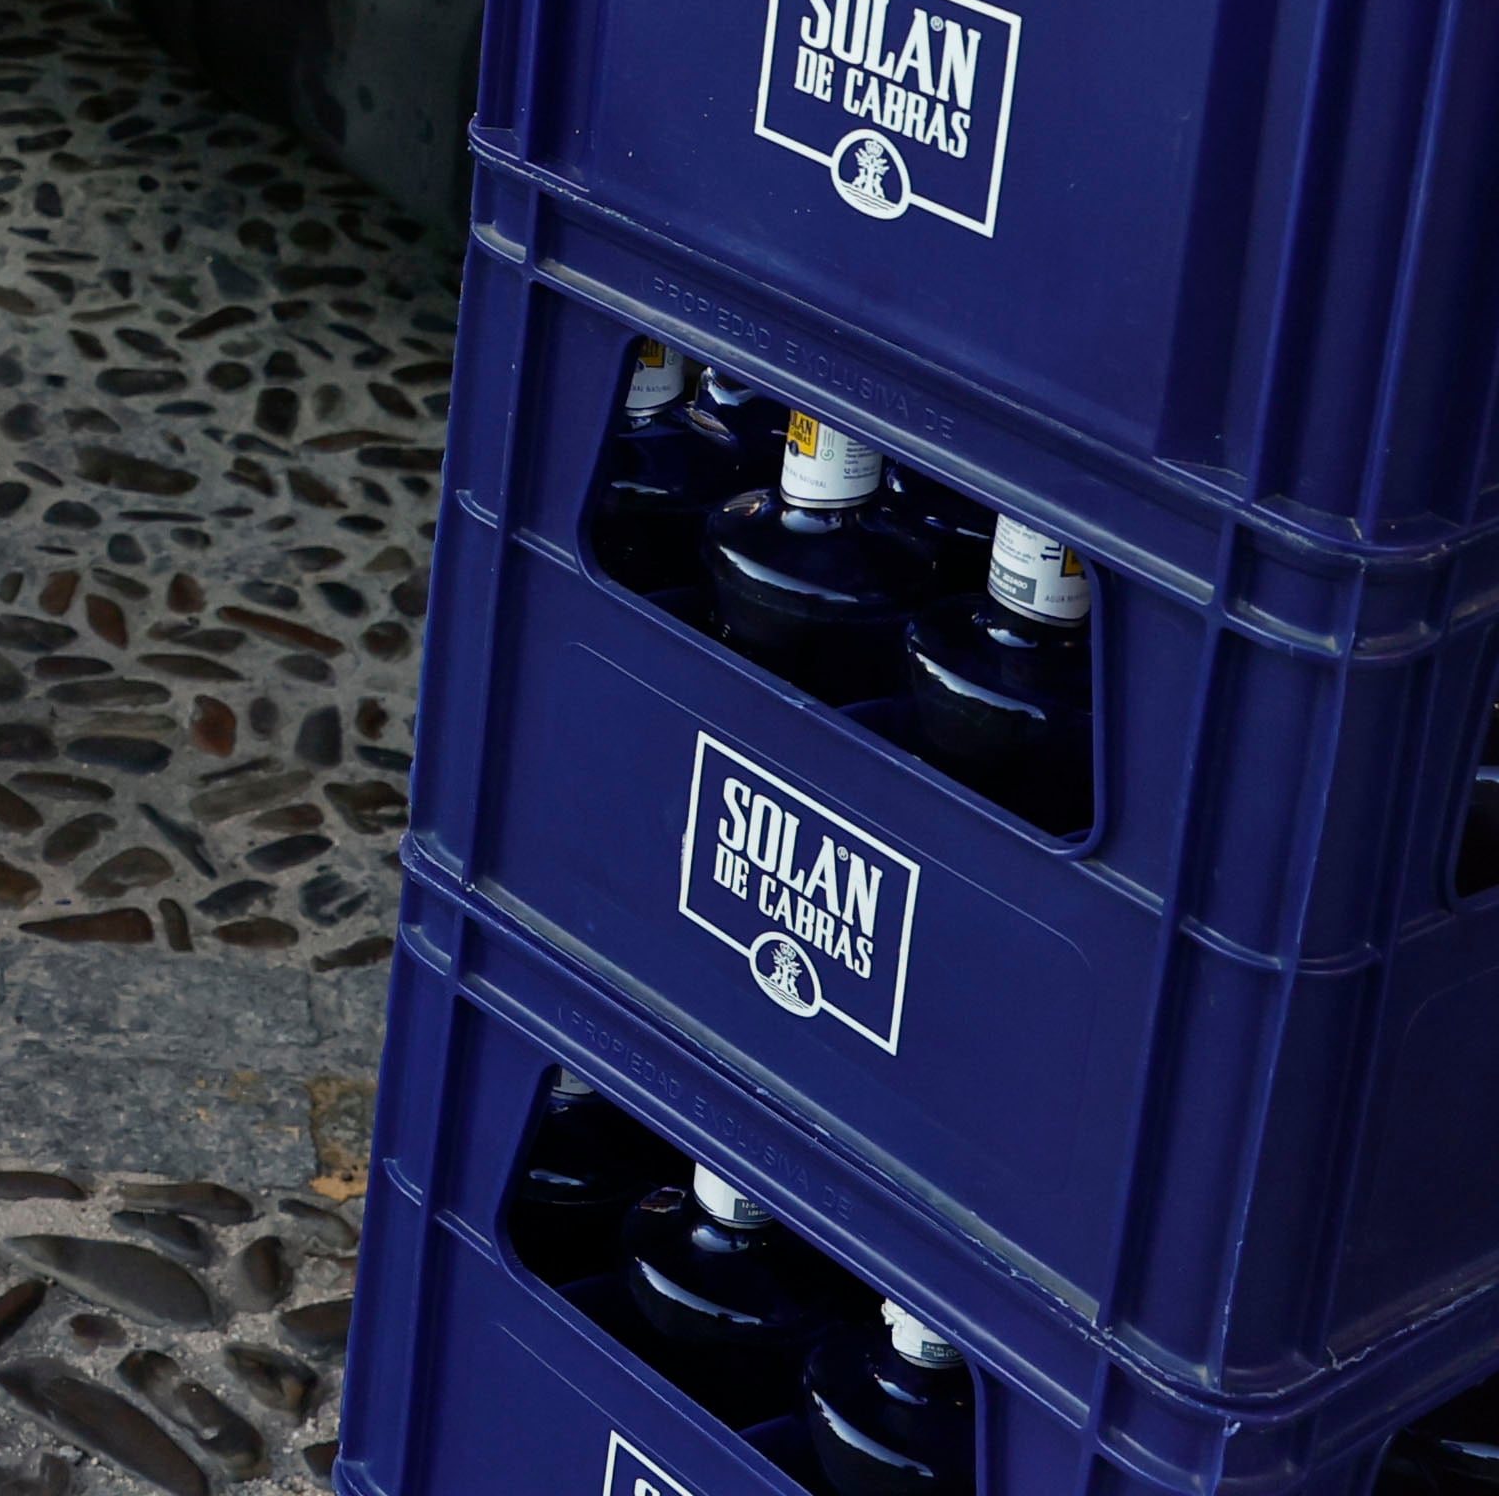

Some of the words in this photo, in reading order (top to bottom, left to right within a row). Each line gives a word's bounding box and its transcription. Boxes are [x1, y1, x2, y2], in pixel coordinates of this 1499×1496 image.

[794, 45, 835, 103] DE
[843, 67, 971, 159] CABRAS
[653, 276, 772, 351] PROPIEDAD
[786, 337, 911, 421] EXCLUSIVA
[923, 406, 954, 441] DE
[713, 842, 749, 901] DE
[758, 874, 874, 980] CABRAS
[718, 777, 883, 938] SOLAN
[570, 1009, 683, 1101] PROPIEDAD
